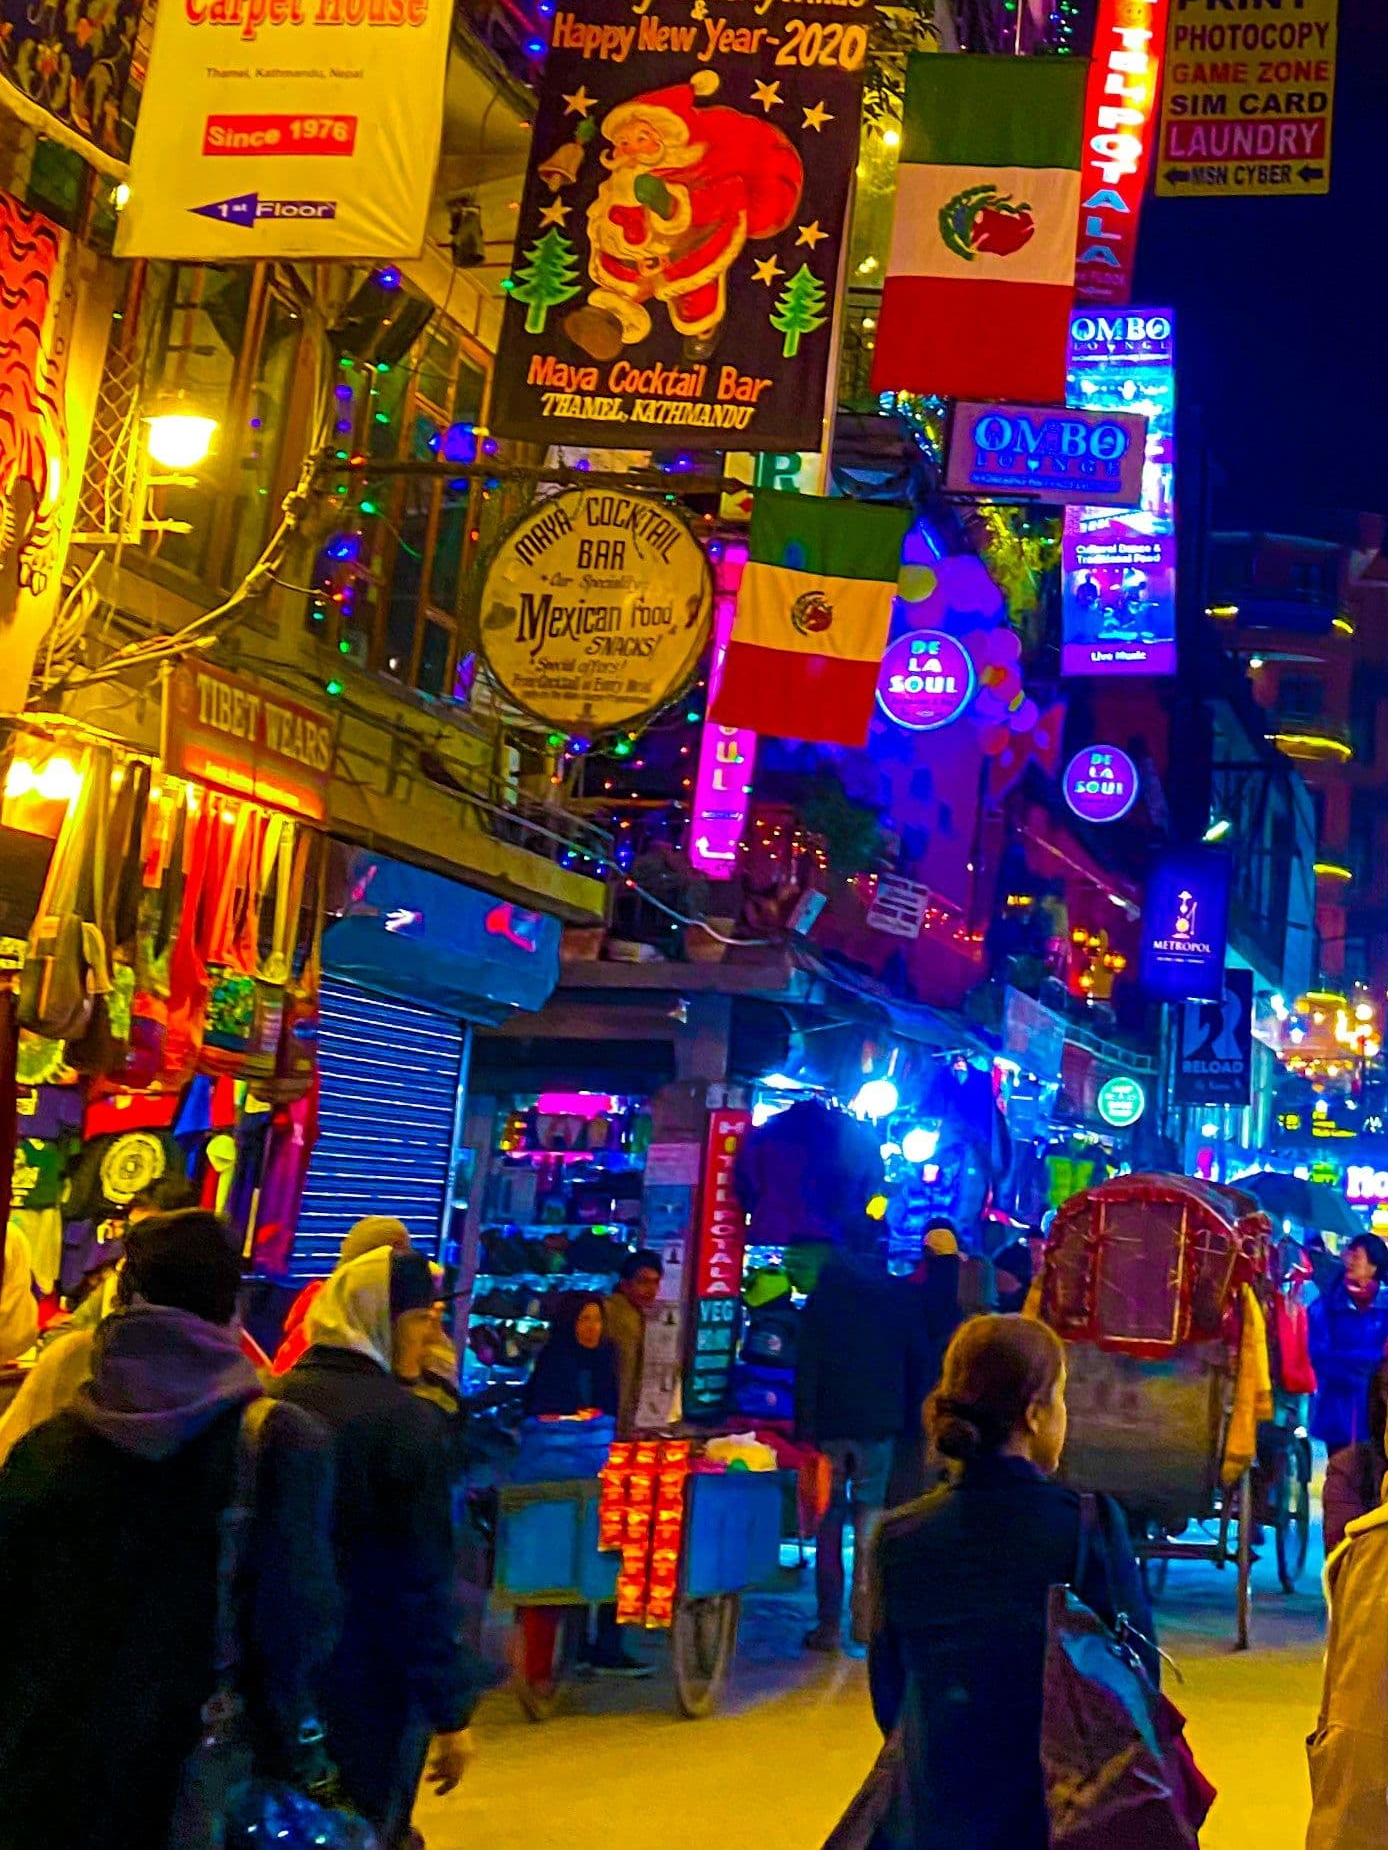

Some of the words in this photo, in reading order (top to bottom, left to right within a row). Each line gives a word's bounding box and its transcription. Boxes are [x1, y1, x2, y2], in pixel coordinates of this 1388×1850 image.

[690, 0, 709, 20] &
[552, 11, 636, 62] Happy
[637, 15, 697, 52] New
[1174, 22, 1329, 50] PHOTOCOPY
[1172, 62, 1249, 85] GAME
[1258, 60, 1329, 84] ZONE
[1170, 94, 1227, 116] SIM
[1239, 92, 1328, 116] CARD
[207, 125, 281, 149] Since
[289, 118, 348, 142] 1976
[1169, 123, 1319, 158] LAUNDRY
[1234, 165, 1292, 185] CYBER
[217, 202, 248, 218] 1st
[255, 202, 330, 218] Floor
[1071, 317, 1171, 342] OMBO
[527, 354, 599, 393] Maya
[608, 361, 708, 398] Cocktail
[717, 366, 774, 402] Bar
[541, 392, 628, 423] THAMEL,
[631, 400, 756, 430] KATHMANDU
[974, 416, 1127, 461] OMBO
[514, 508, 574, 567] MAYA
[586, 496, 681, 565] COCKTAIL
[578, 539, 626, 571] BAR
[515, 593, 622, 657] Mexican
[911, 640, 941, 655] DE
[908, 658, 943, 673] LA
[888, 675, 958, 694] SOUL
[197, 672, 260, 742] TIBET
[265, 701, 331, 772] WEARS
[1091, 754, 1113, 765] DE
[1088, 767, 1114, 779] LA
[1074, 781, 1123, 796] SOUL
[1153, 940, 1212, 954] METROPOL
[1183, 1060, 1245, 1075] RELOAD
[700, 1301, 733, 1322] VEG
